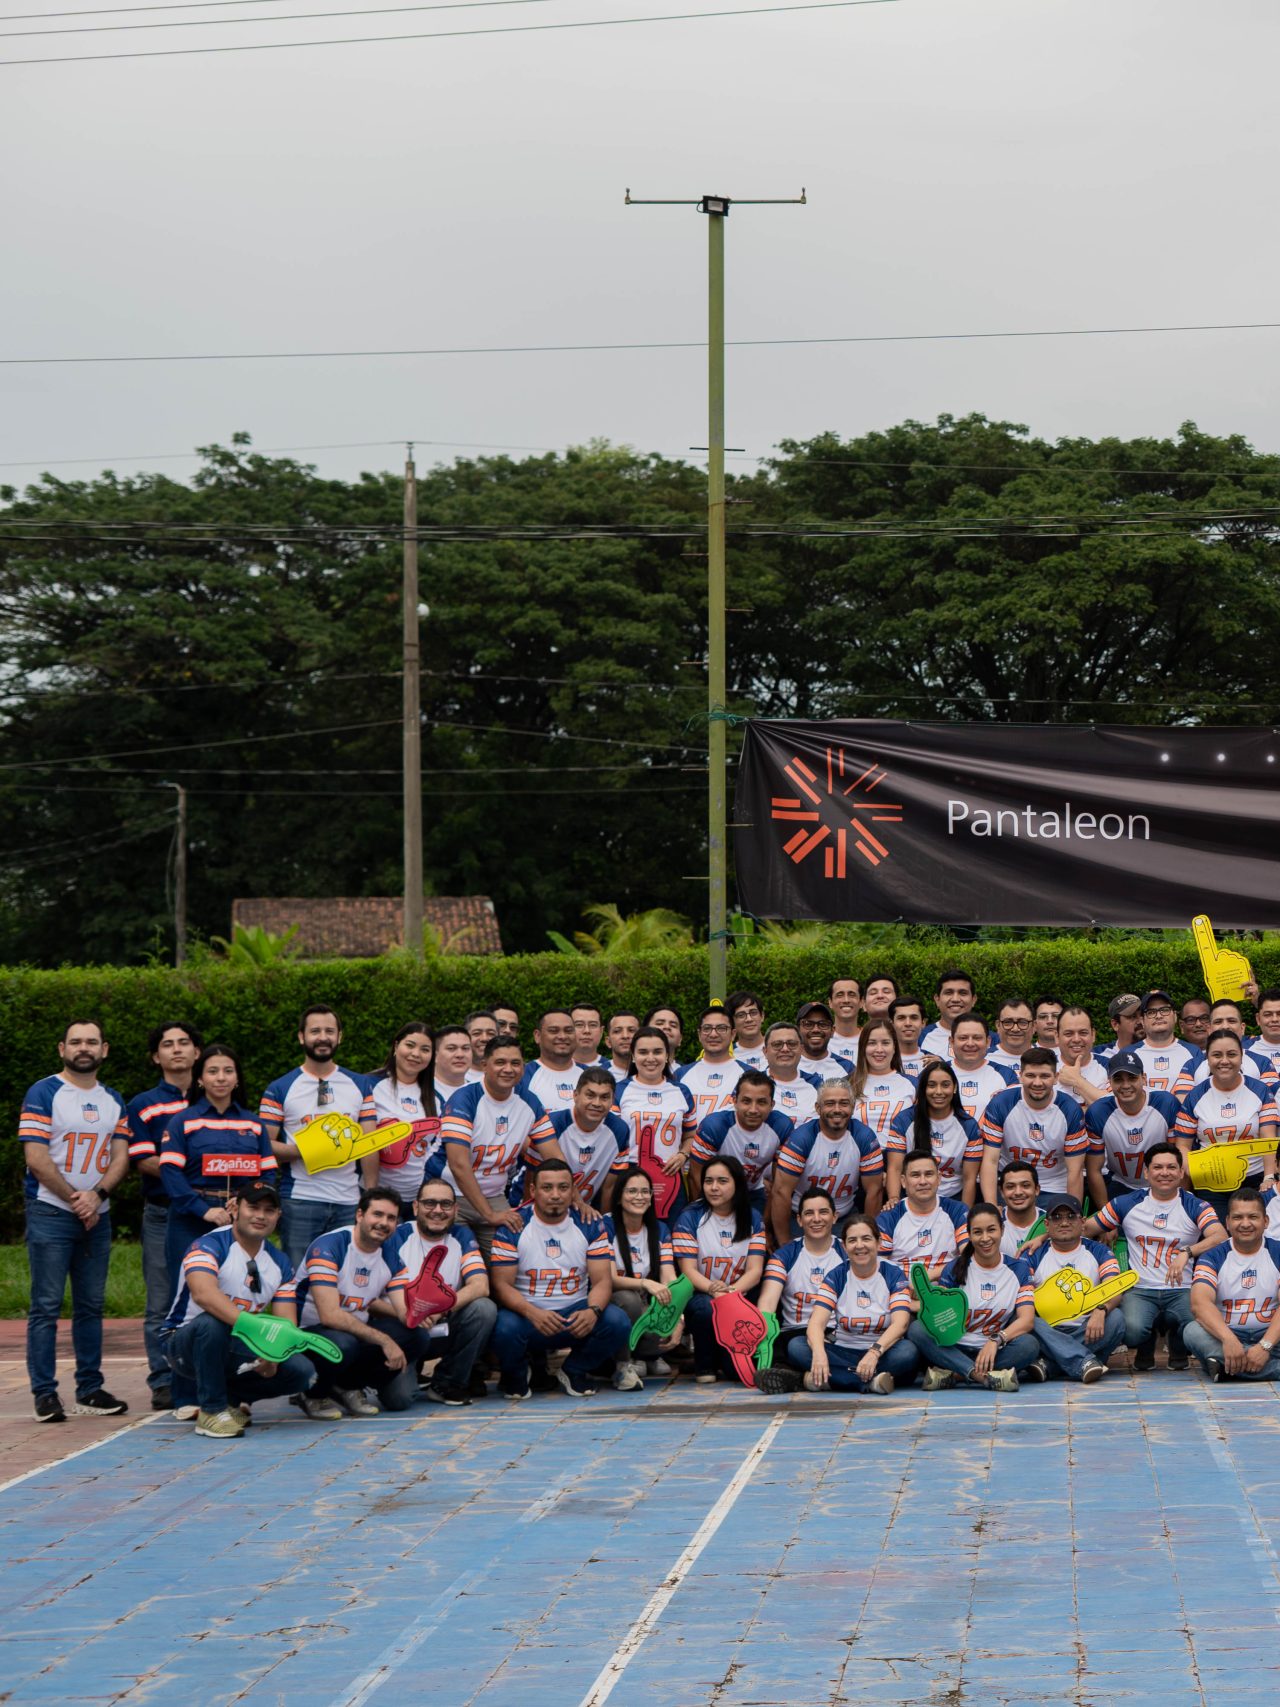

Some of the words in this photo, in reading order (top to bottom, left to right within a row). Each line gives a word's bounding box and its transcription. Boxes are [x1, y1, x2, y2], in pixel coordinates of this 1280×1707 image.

[947, 800, 1151, 839] Pantaleon
[630, 1111, 677, 1146] 176
[63, 1132, 111, 1174] 176
[228, 1157, 257, 1169] años
[1113, 1150, 1145, 1179] 17
[1135, 1234, 1182, 1268] 176
[525, 1266, 581, 1297] 176
[702, 1256, 747, 1286] 176
[1222, 1297, 1276, 1325] 176
